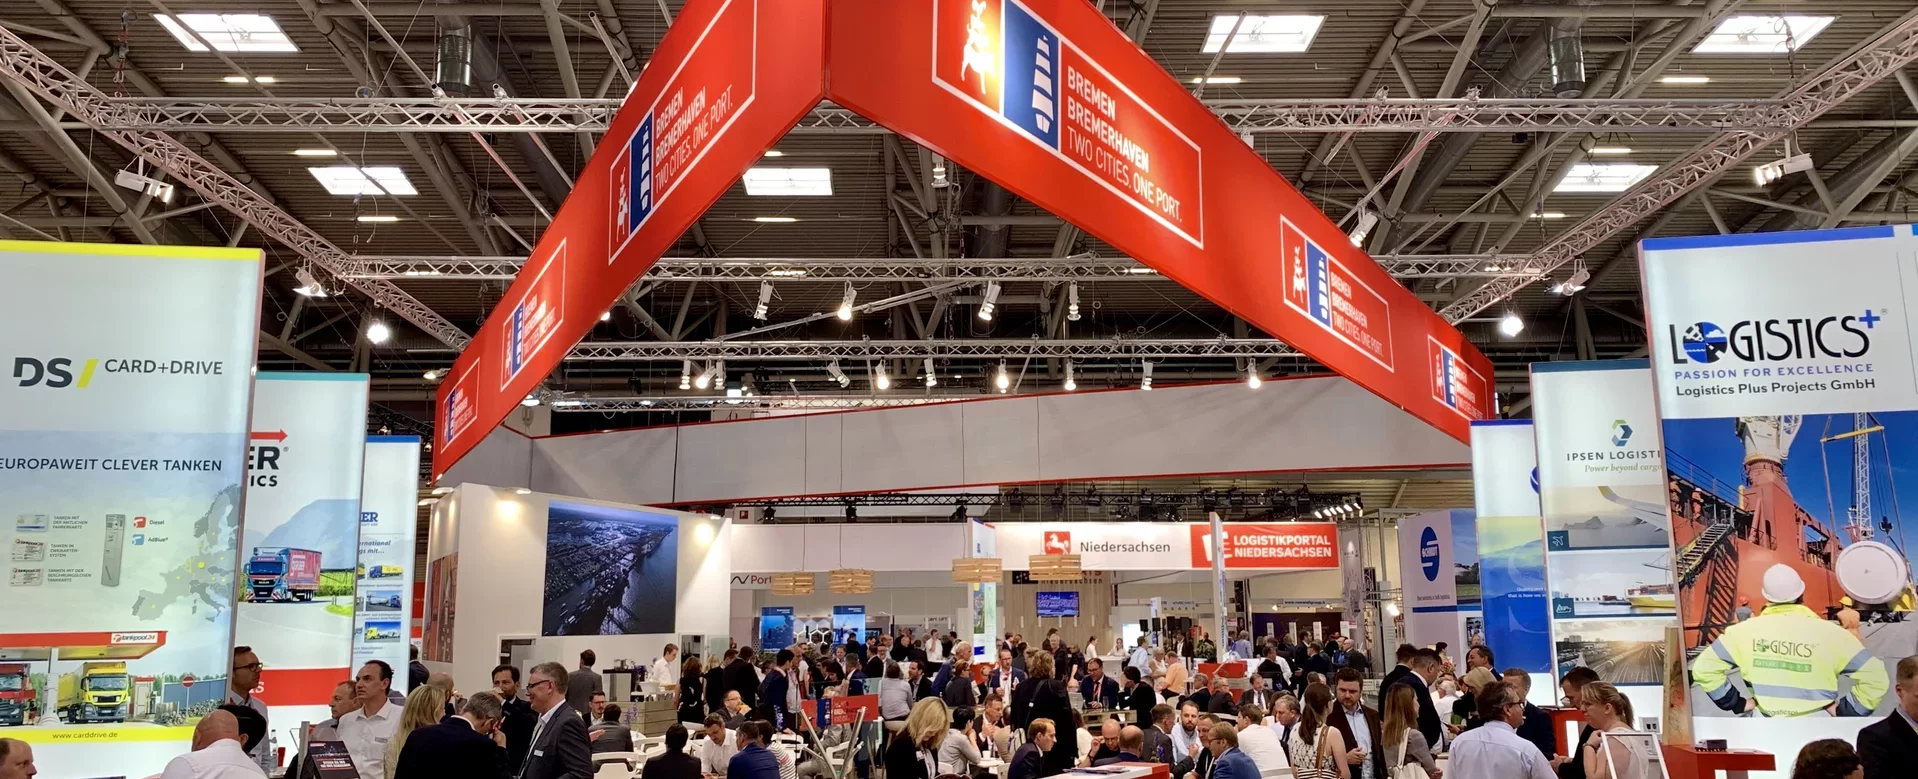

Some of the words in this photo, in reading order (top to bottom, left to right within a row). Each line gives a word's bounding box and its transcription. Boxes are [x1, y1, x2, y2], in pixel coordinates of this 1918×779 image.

[1068, 66, 1116, 121] BREMEN
[656, 86, 683, 139] BREMEN
[656, 86, 706, 168] BREMERHAVEN
[1068, 96, 1149, 173] BREMERHAVEN
[655, 162, 668, 194] TWO
[670, 135, 692, 176] CITIES.
[693, 112, 709, 149] ONE
[710, 84, 733, 130] PORT.
[1067, 126, 1093, 162] TWO
[1096, 146, 1131, 189] CITIES.
[1133, 172, 1154, 204] ONE
[1156, 187, 1182, 222] PORT.
[104, 358, 223, 375] CARD+DRIVE
[1674, 369, 1737, 380] PASSION
[1744, 368, 1771, 377] FOR
[1778, 363, 1874, 376] EXCELLENCE
[1676, 384, 1735, 398] Logistics
[1738, 383, 1768, 394] Plus
[1772, 381, 1827, 394] Projects
[1831, 378, 1876, 389] GmbH
[1566, 452, 1604, 461] IPSEN
[1610, 450, 1660, 460] LOGISTI
[0, 458, 98, 470] EUROPAWEIT
[102, 459, 158, 470] CLEVER
[163, 459, 222, 471] TANKEN
[1584, 464, 1609, 472] Power
[1611, 463, 1638, 473] beyond
[1080, 540, 1170, 553] Niedersachsen
[1234, 535, 1330, 545] LOGISTIKPORTAL
[1235, 547, 1332, 558] NIEDERSACHSEN
